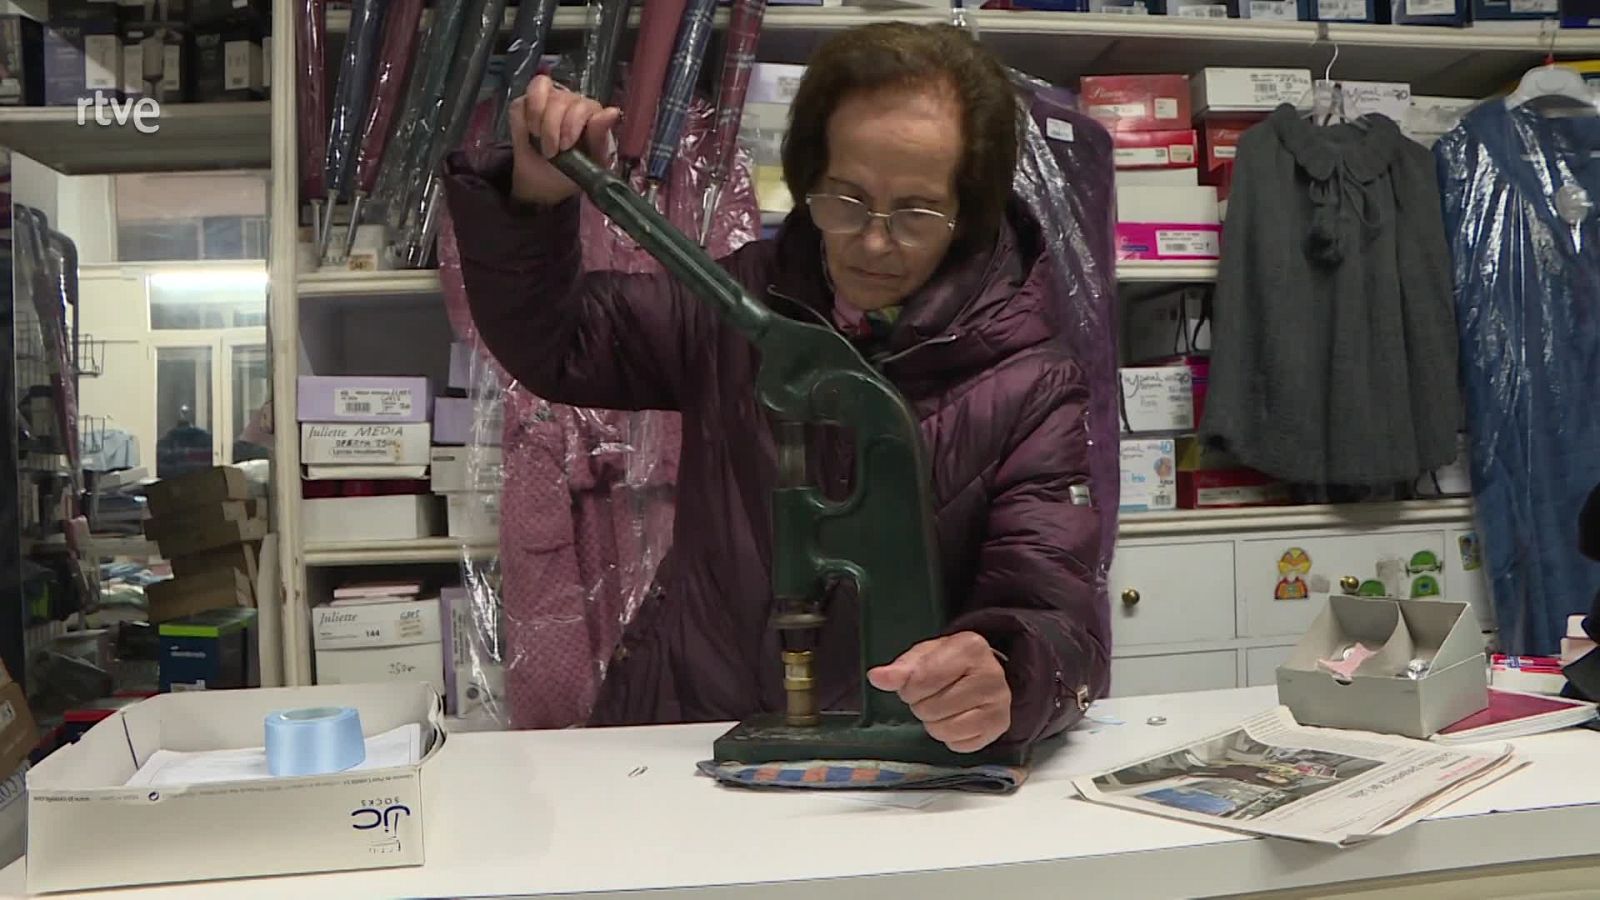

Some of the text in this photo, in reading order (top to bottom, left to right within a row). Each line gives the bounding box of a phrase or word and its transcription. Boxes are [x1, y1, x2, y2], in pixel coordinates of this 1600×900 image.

[309, 426, 347, 438] Juliette
[354, 426, 403, 437] MEDIA
[319, 611, 358, 625] Juliette
[366, 629, 380, 638] 144
[361, 796, 400, 807] SOCKS
